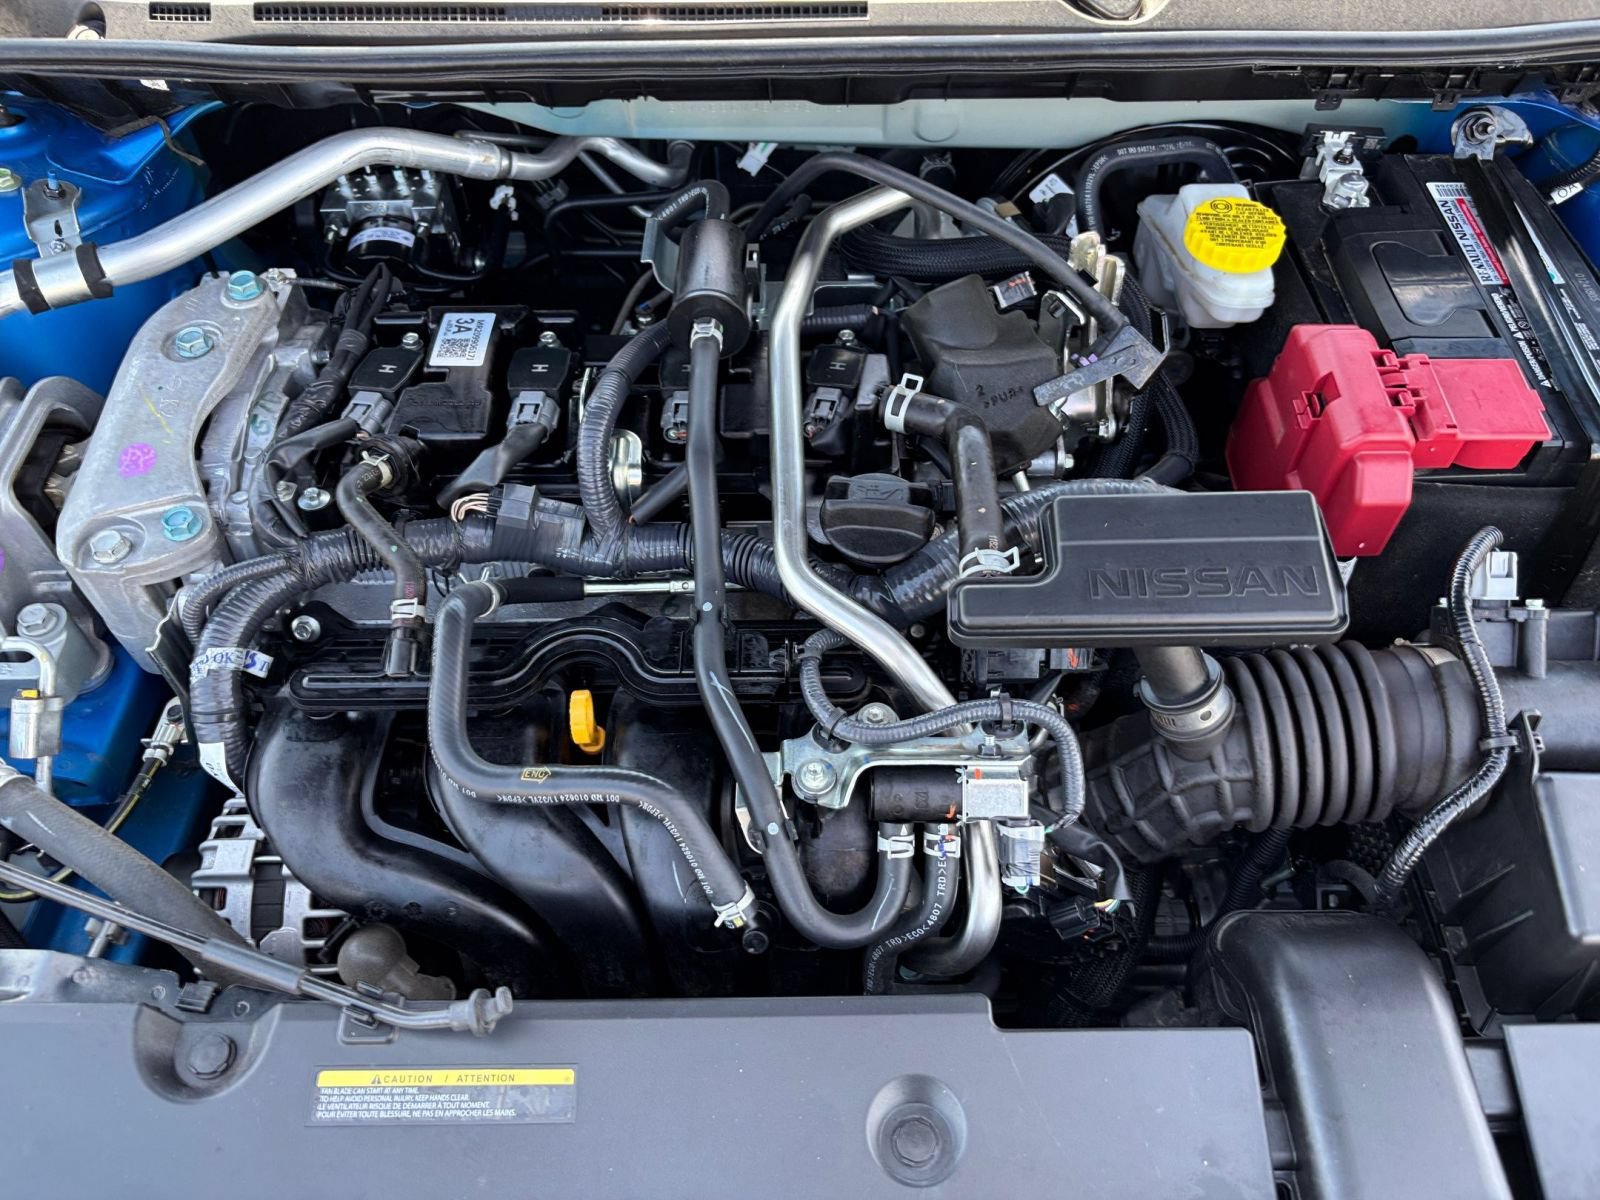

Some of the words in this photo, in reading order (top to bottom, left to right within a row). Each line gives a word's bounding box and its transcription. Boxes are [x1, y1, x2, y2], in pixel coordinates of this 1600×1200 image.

[1439, 200, 1470, 241] NISSAN
[1462, 243, 1492, 282] RENAULT
[452, 318, 475, 334] 3A
[531, 364, 550, 372] H
[830, 361, 847, 370] H
[1088, 565, 1321, 599] NISSAN
[384, 1074, 432, 1084] CAUTION
[456, 1074, 516, 1082] ATTENTION
[365, 1094, 394, 1102] PERSONAL
[414, 1094, 429, 1102] KEEP
[328, 1102, 368, 1110] VENTILATEUR
[369, 1102, 392, 1110] RISQUE
[392, 1102, 401, 1110] DE
[359, 1110, 378, 1118] TOUTE
[412, 1110, 422, 1118] NE
[434, 1109, 444, 1117] EN
[483, 1108, 494, 1116] LES
